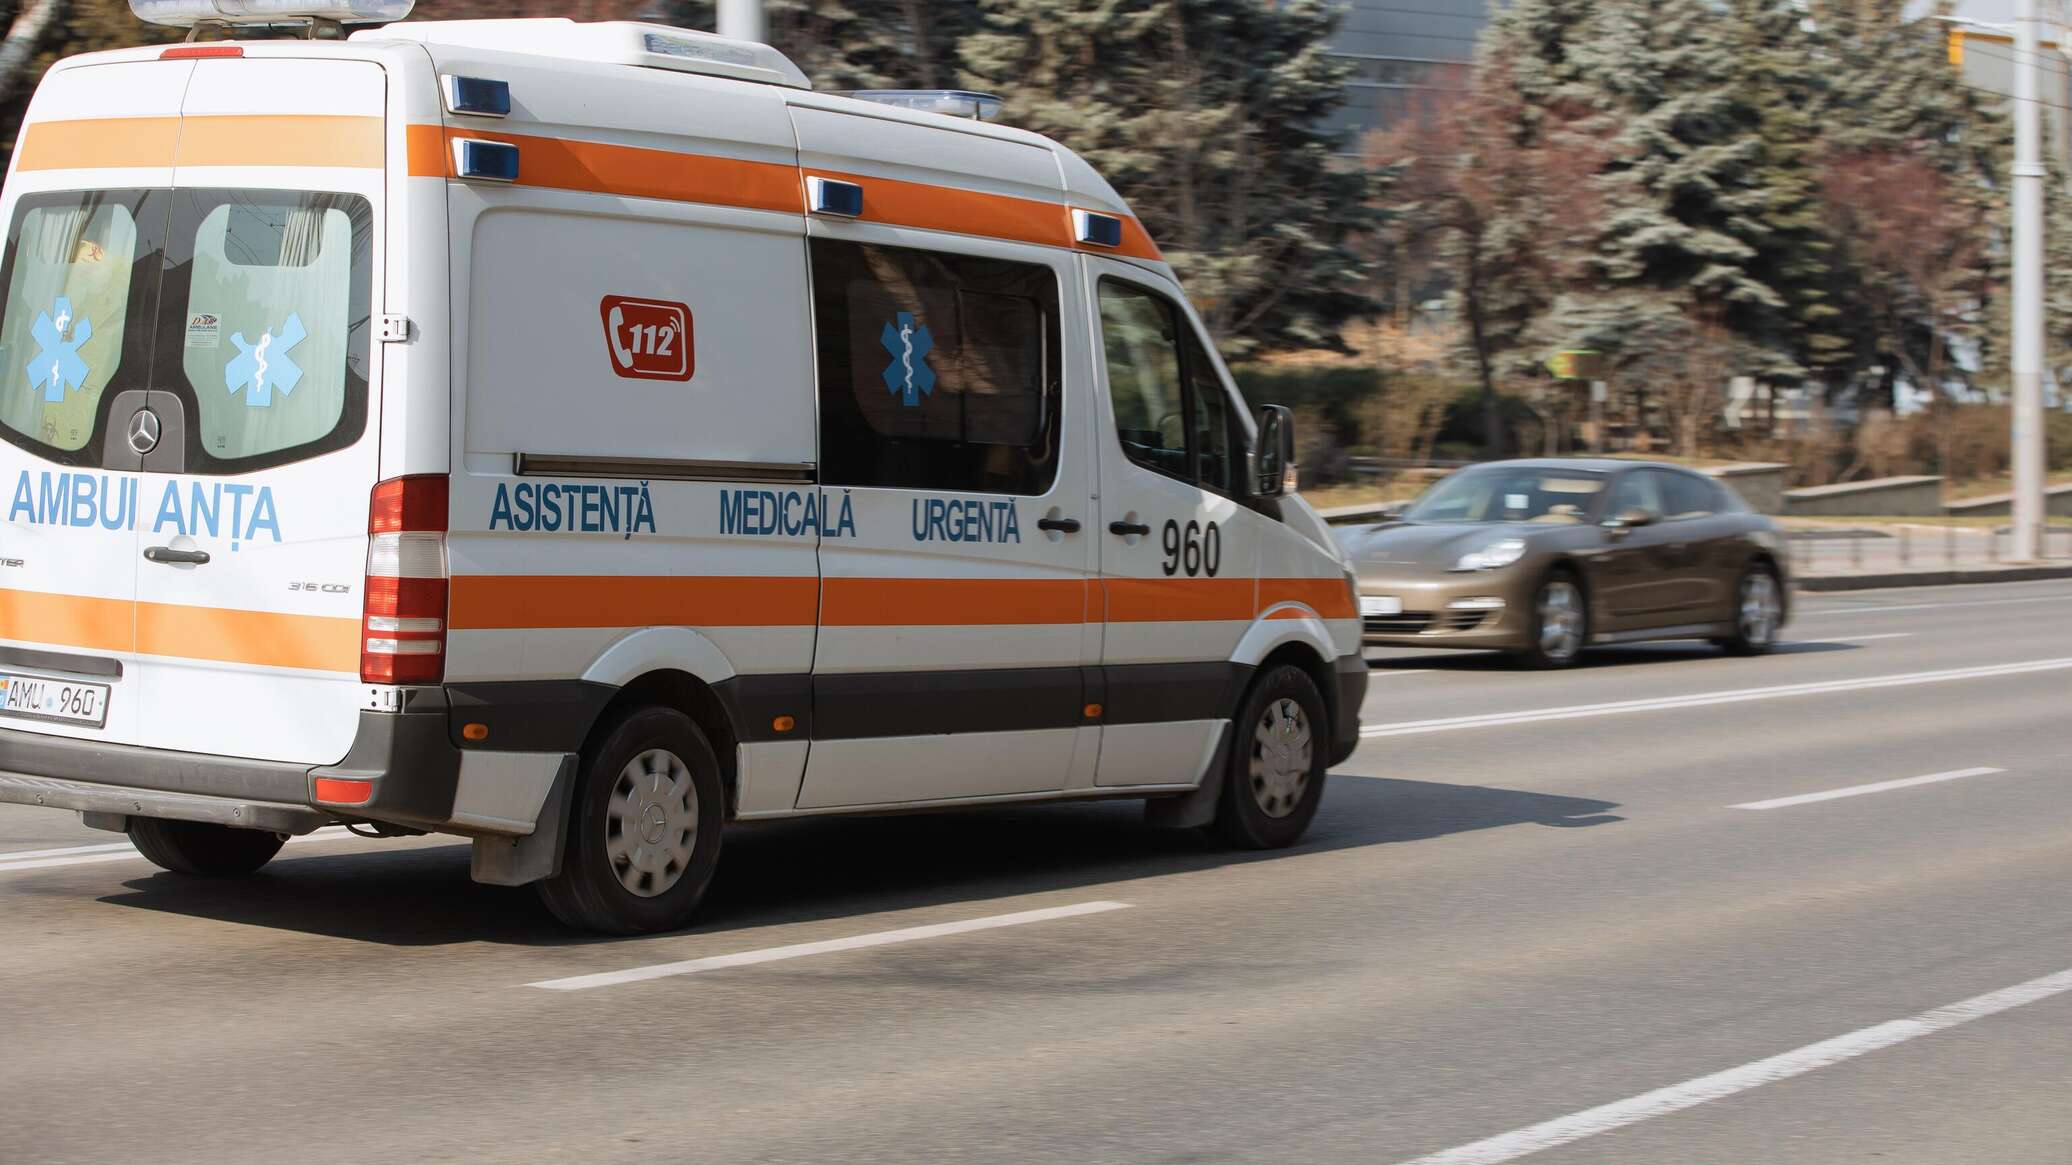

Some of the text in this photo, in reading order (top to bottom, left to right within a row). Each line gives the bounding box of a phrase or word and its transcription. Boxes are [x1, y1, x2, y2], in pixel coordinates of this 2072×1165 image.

[629, 323, 675, 356] 112
[719, 488, 857, 538] MEDICALĂ
[1161, 518, 1221, 578] 960
[288, 582, 319, 592] 316
[8, 680, 95, 716] AMU 960
